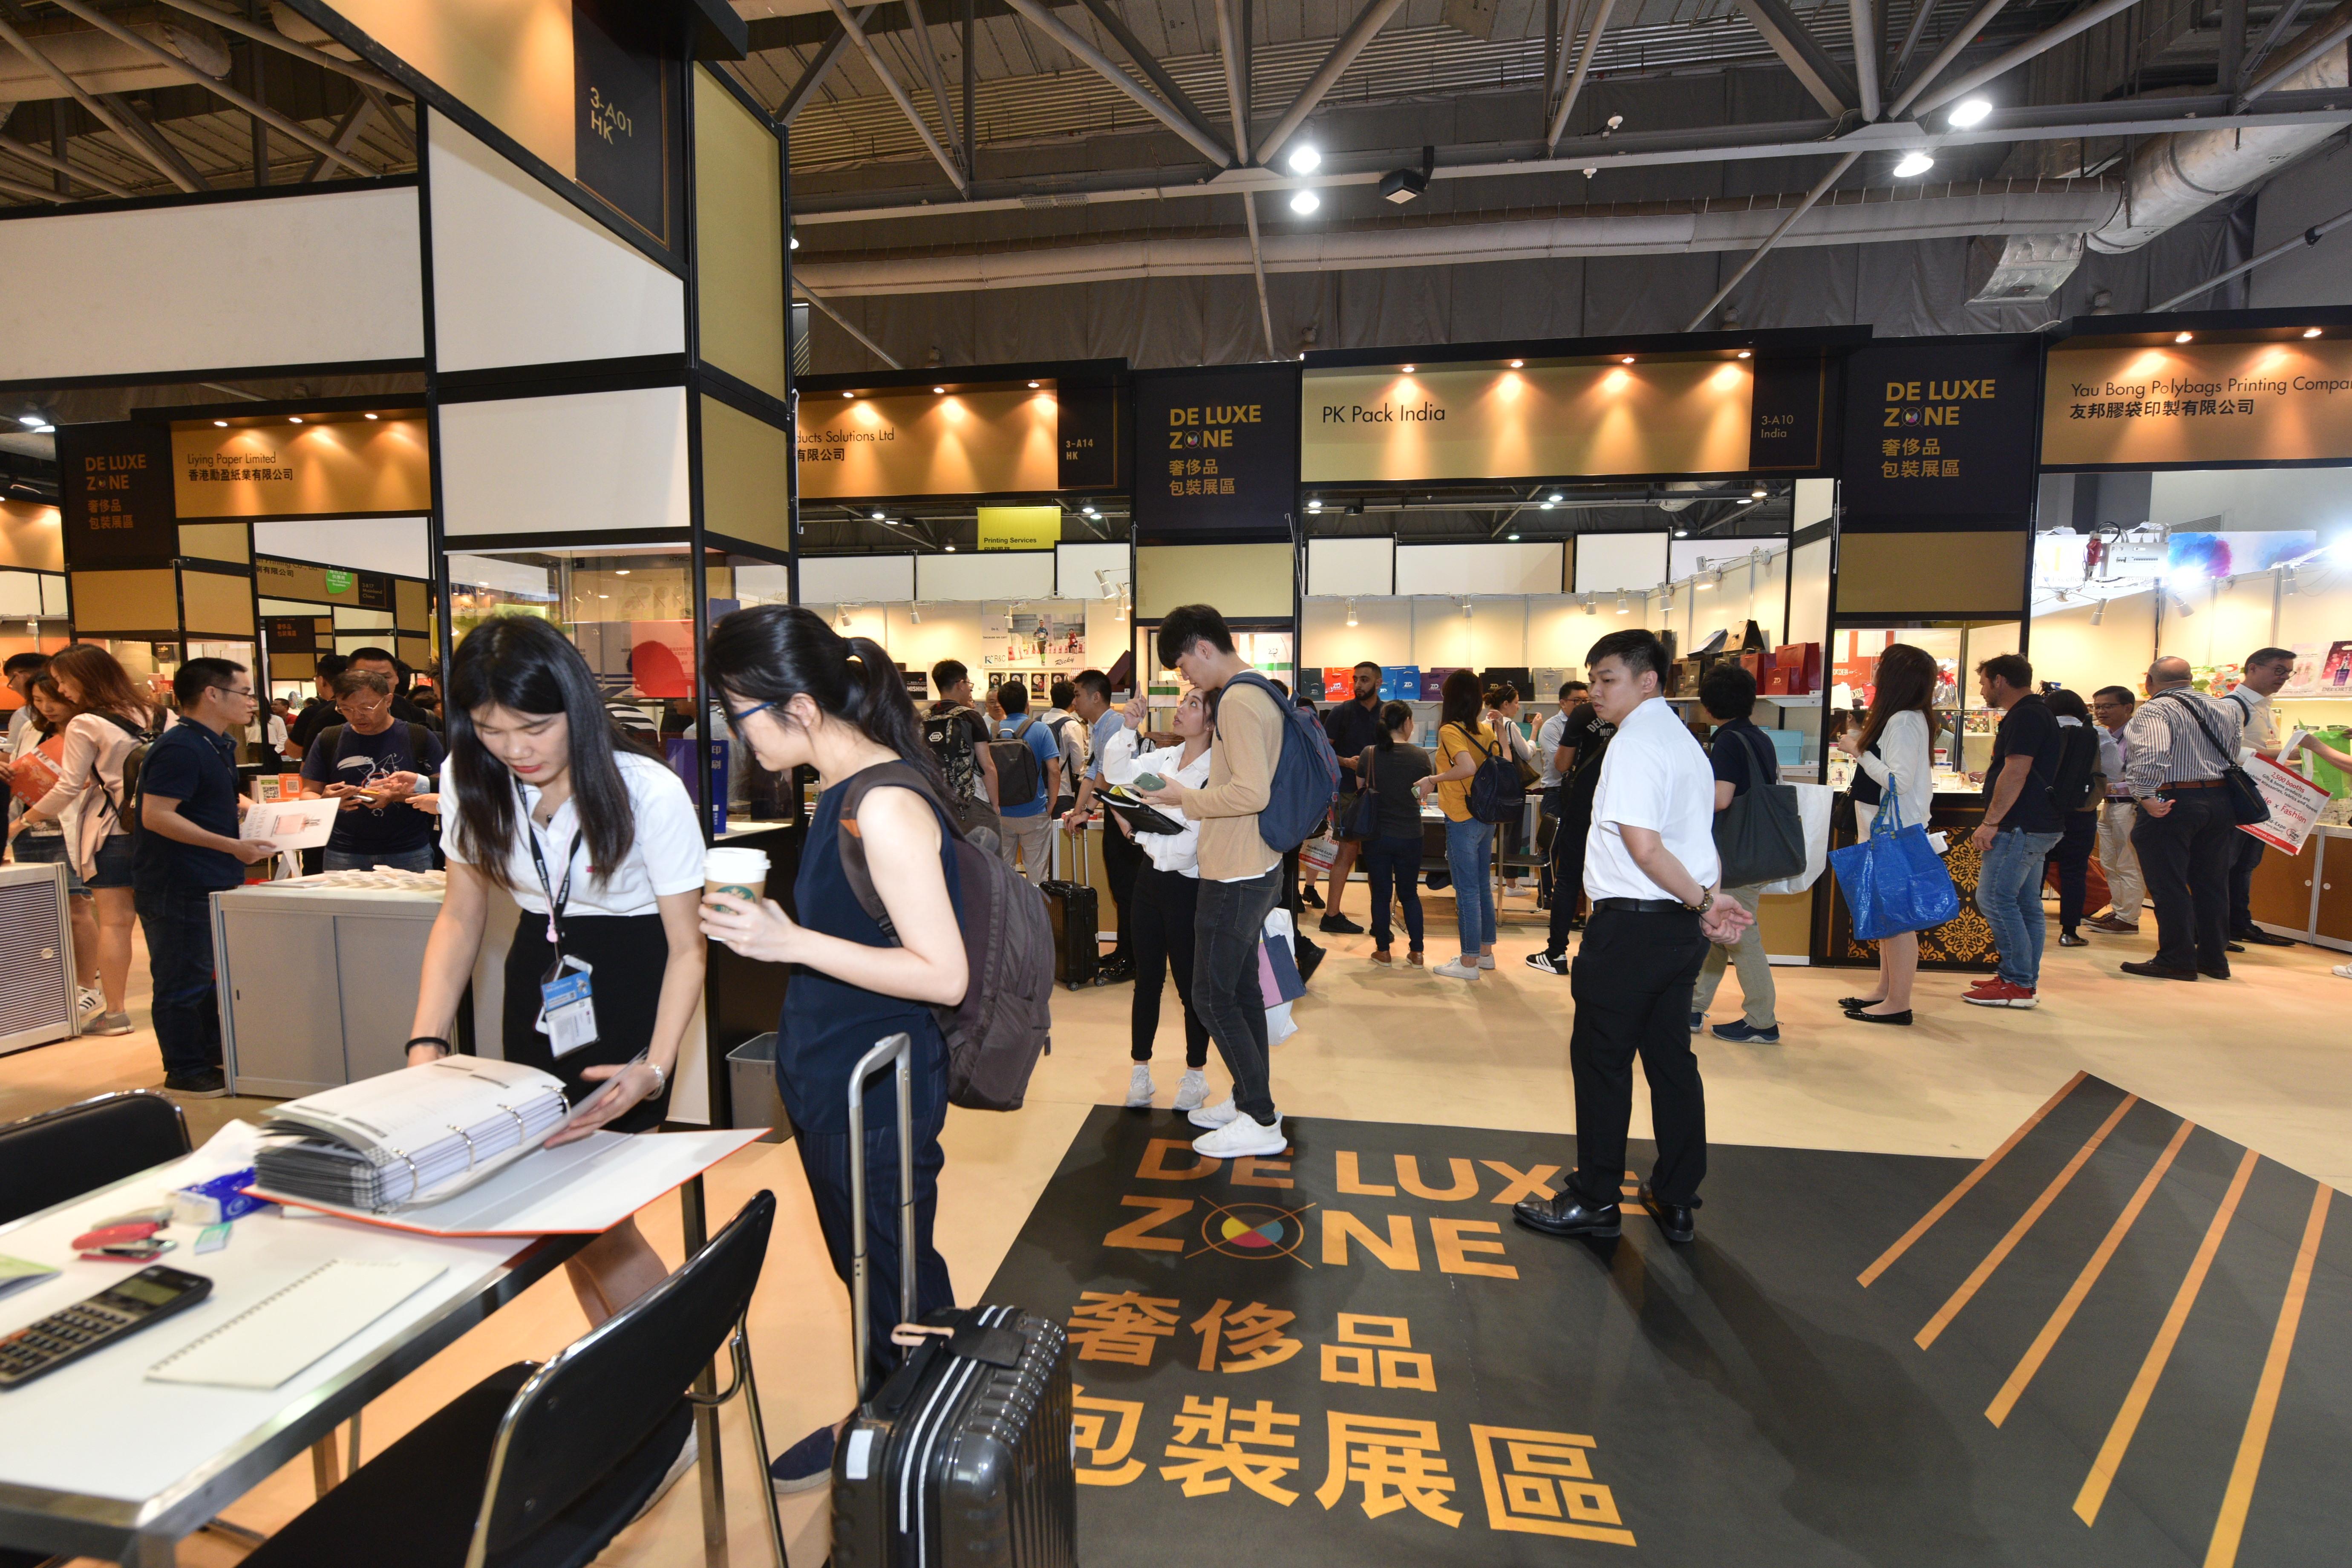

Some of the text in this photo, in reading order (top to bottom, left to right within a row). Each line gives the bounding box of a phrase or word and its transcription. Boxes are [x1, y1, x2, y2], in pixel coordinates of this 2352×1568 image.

[591, 87, 631, 137] 3-A01
[591, 110, 614, 145] HK
[1886, 379, 1996, 401] DE LUXE
[2072, 383, 2099, 397] Yau
[2106, 382, 2145, 399] Bong
[2152, 378, 2221, 398] Polybags
[2228, 378, 2287, 395] Printing
[1170, 405, 1261, 426] DE LUXE
[1323, 401, 1445, 423] PK Pack India
[2070, 398, 2254, 419] 友邦膠袋印製有限公司
[1761, 415, 1793, 425] 3-A10
[826, 429, 875, 442] Solutions
[879, 427, 894, 441] Ltd
[1761, 427, 1787, 438] India
[1066, 439, 1093, 448] 3-A14
[1882, 438, 1940, 456] 奢侈品
[85, 454, 147, 472] DE LUXE
[187, 451, 276, 467] Liying Paper Limited
[1066, 452, 1078, 460] HK
[1169, 458, 1218, 476] 奢侈品
[1881, 459, 1960, 478] 包裝展區
[1169, 478, 1235, 496] 包裝展區
[88, 499, 121, 513] 奢侈品
[89, 515, 134, 530] 包裝展區
[1055, 656, 1075, 666] Ricky
[712, 746, 721, 770] 印刷
[2271, 772, 2305, 793] 2,500 booths
[2273, 780, 2285, 789] home
[2285, 787, 2302, 798] products
[2284, 792, 2297, 802] fabrics
[2306, 804, 2318, 813] apparel
[2280, 805, 2306, 824] Fashion
[1067, 1289, 1437, 1392] 奢侈品
